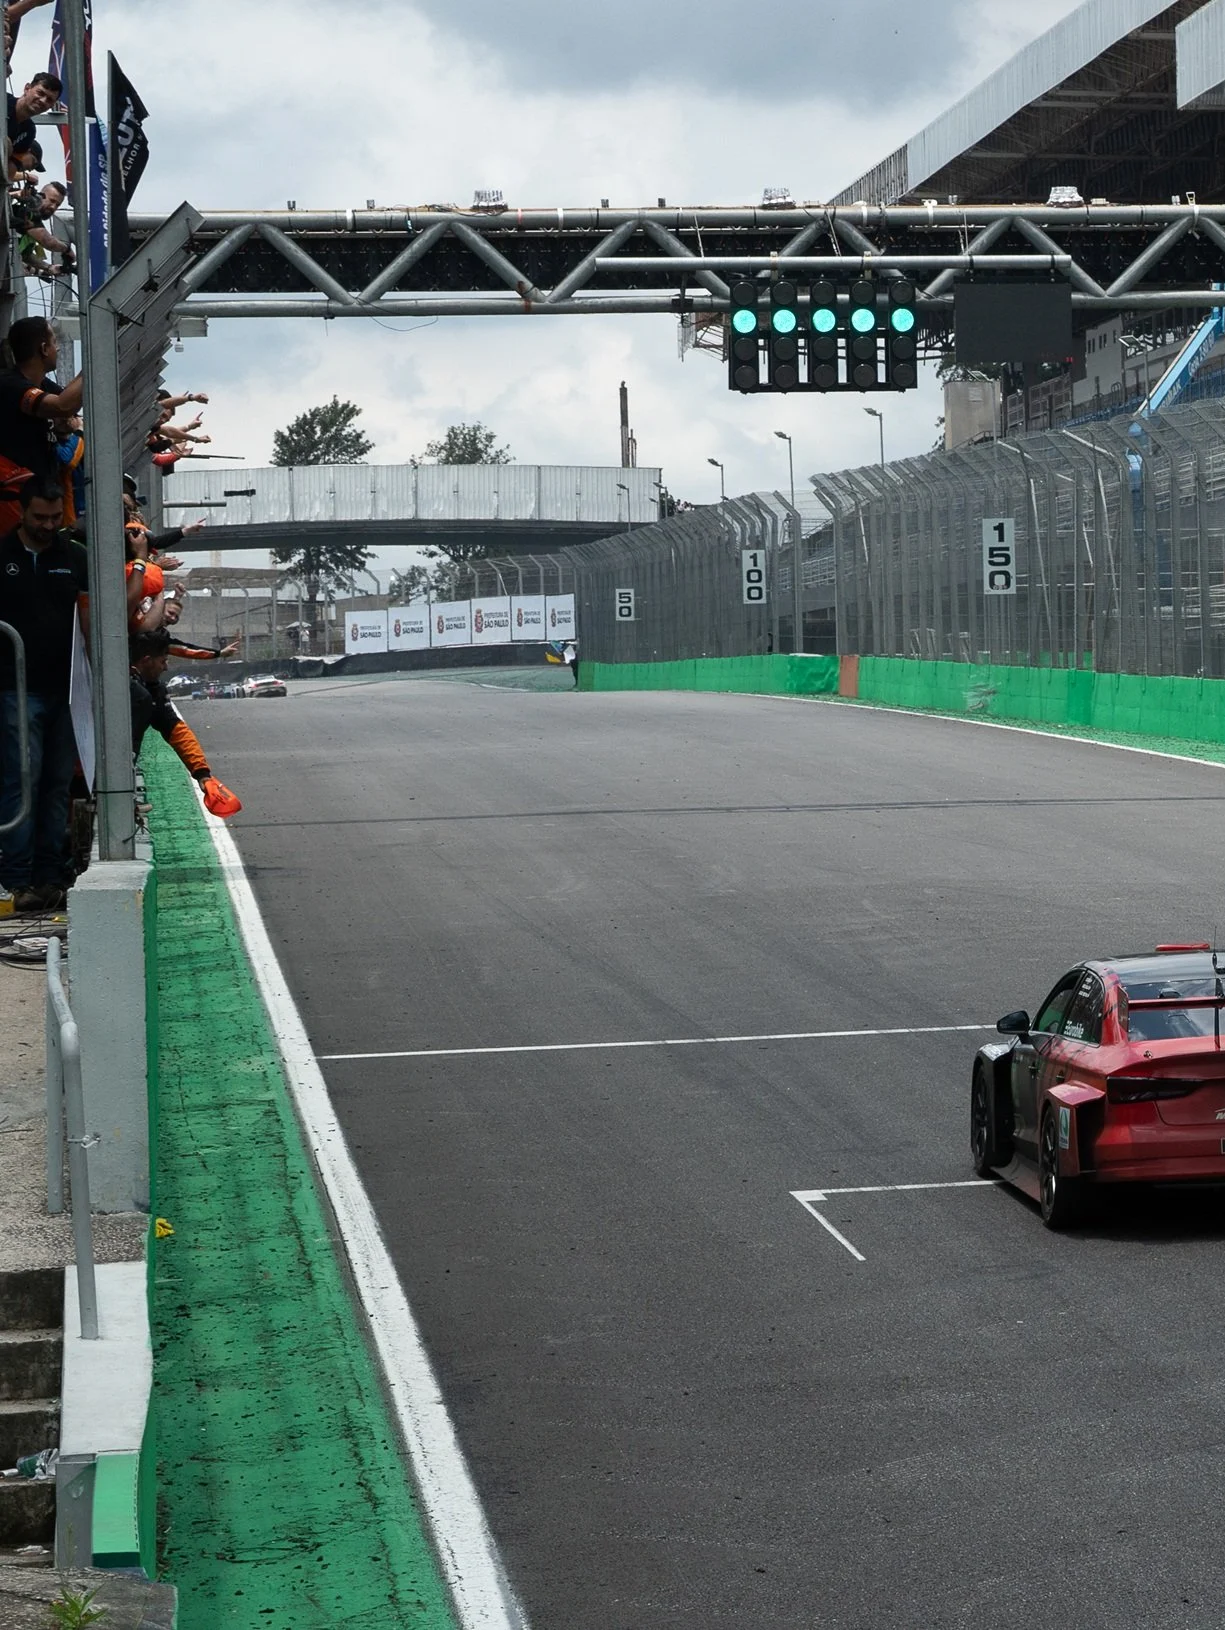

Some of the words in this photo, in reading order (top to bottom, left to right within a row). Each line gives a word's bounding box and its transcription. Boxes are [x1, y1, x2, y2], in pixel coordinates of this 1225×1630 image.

[988, 522, 1011, 590] 150
[746, 553, 763, 600] 100
[618, 592, 632, 618] 50
[493, 619, 509, 628] PAULO
